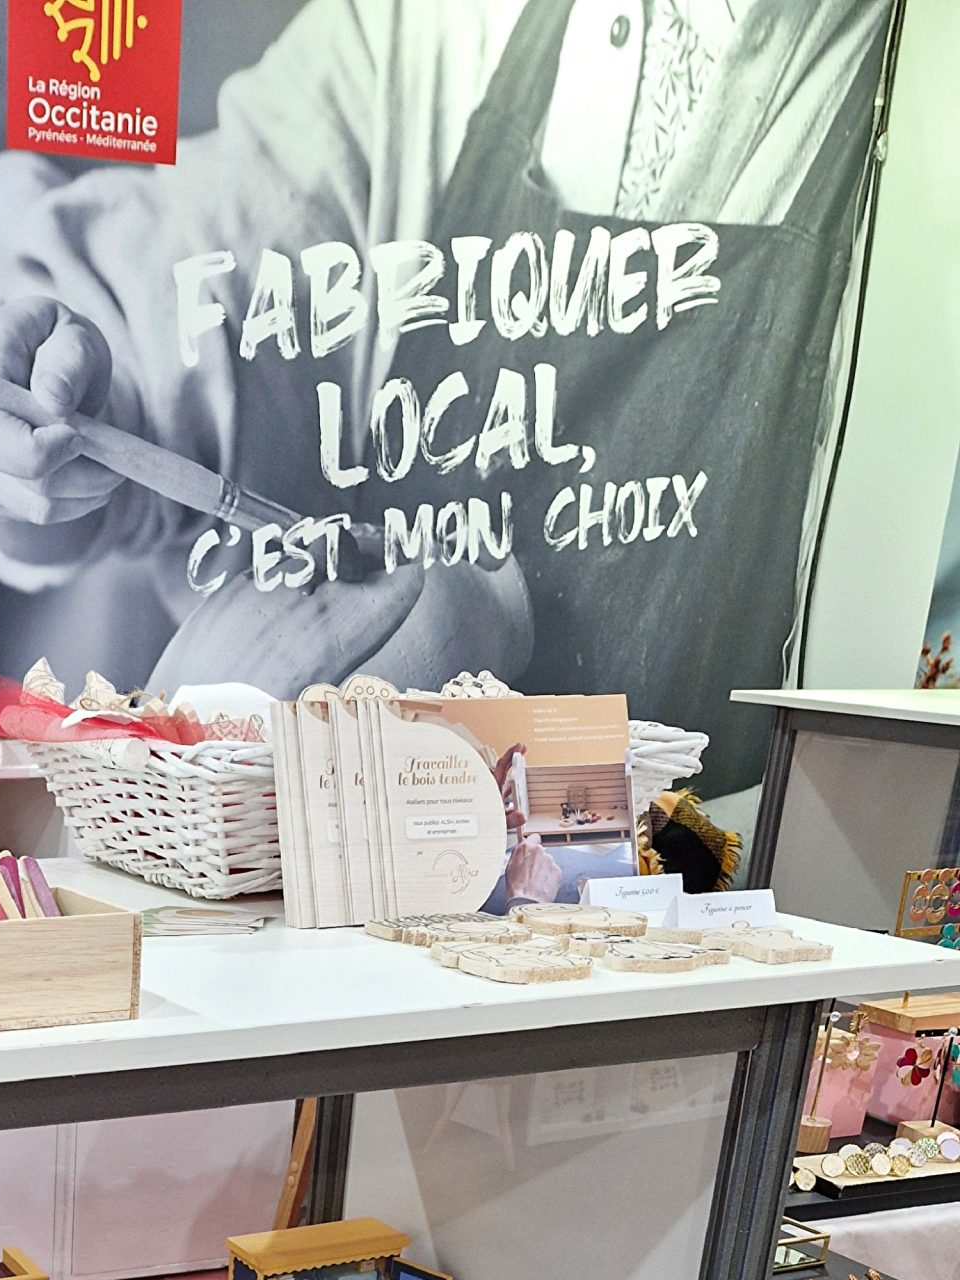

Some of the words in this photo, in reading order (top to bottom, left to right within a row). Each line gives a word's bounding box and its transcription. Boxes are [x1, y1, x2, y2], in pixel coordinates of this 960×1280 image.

[28, 76, 46, 93] La
[49, 79, 101, 100] Région
[28, 97, 158, 136] Occitanie
[28, 127, 78, 144] Pyrénées
[86, 133, 157, 152] Méditerranée
[173, 223, 721, 367] FABRIQUER
[317, 363, 596, 489] LOCAL,
[186, 513, 352, 597] C'EST
[384, 492, 513, 572] MON
[542, 470, 708, 551] CHOIX
[398, 771, 409, 786] le
[412, 771, 436, 786] bois
[440, 770, 479, 785] tendre
[404, 754, 468, 774] Travailler
